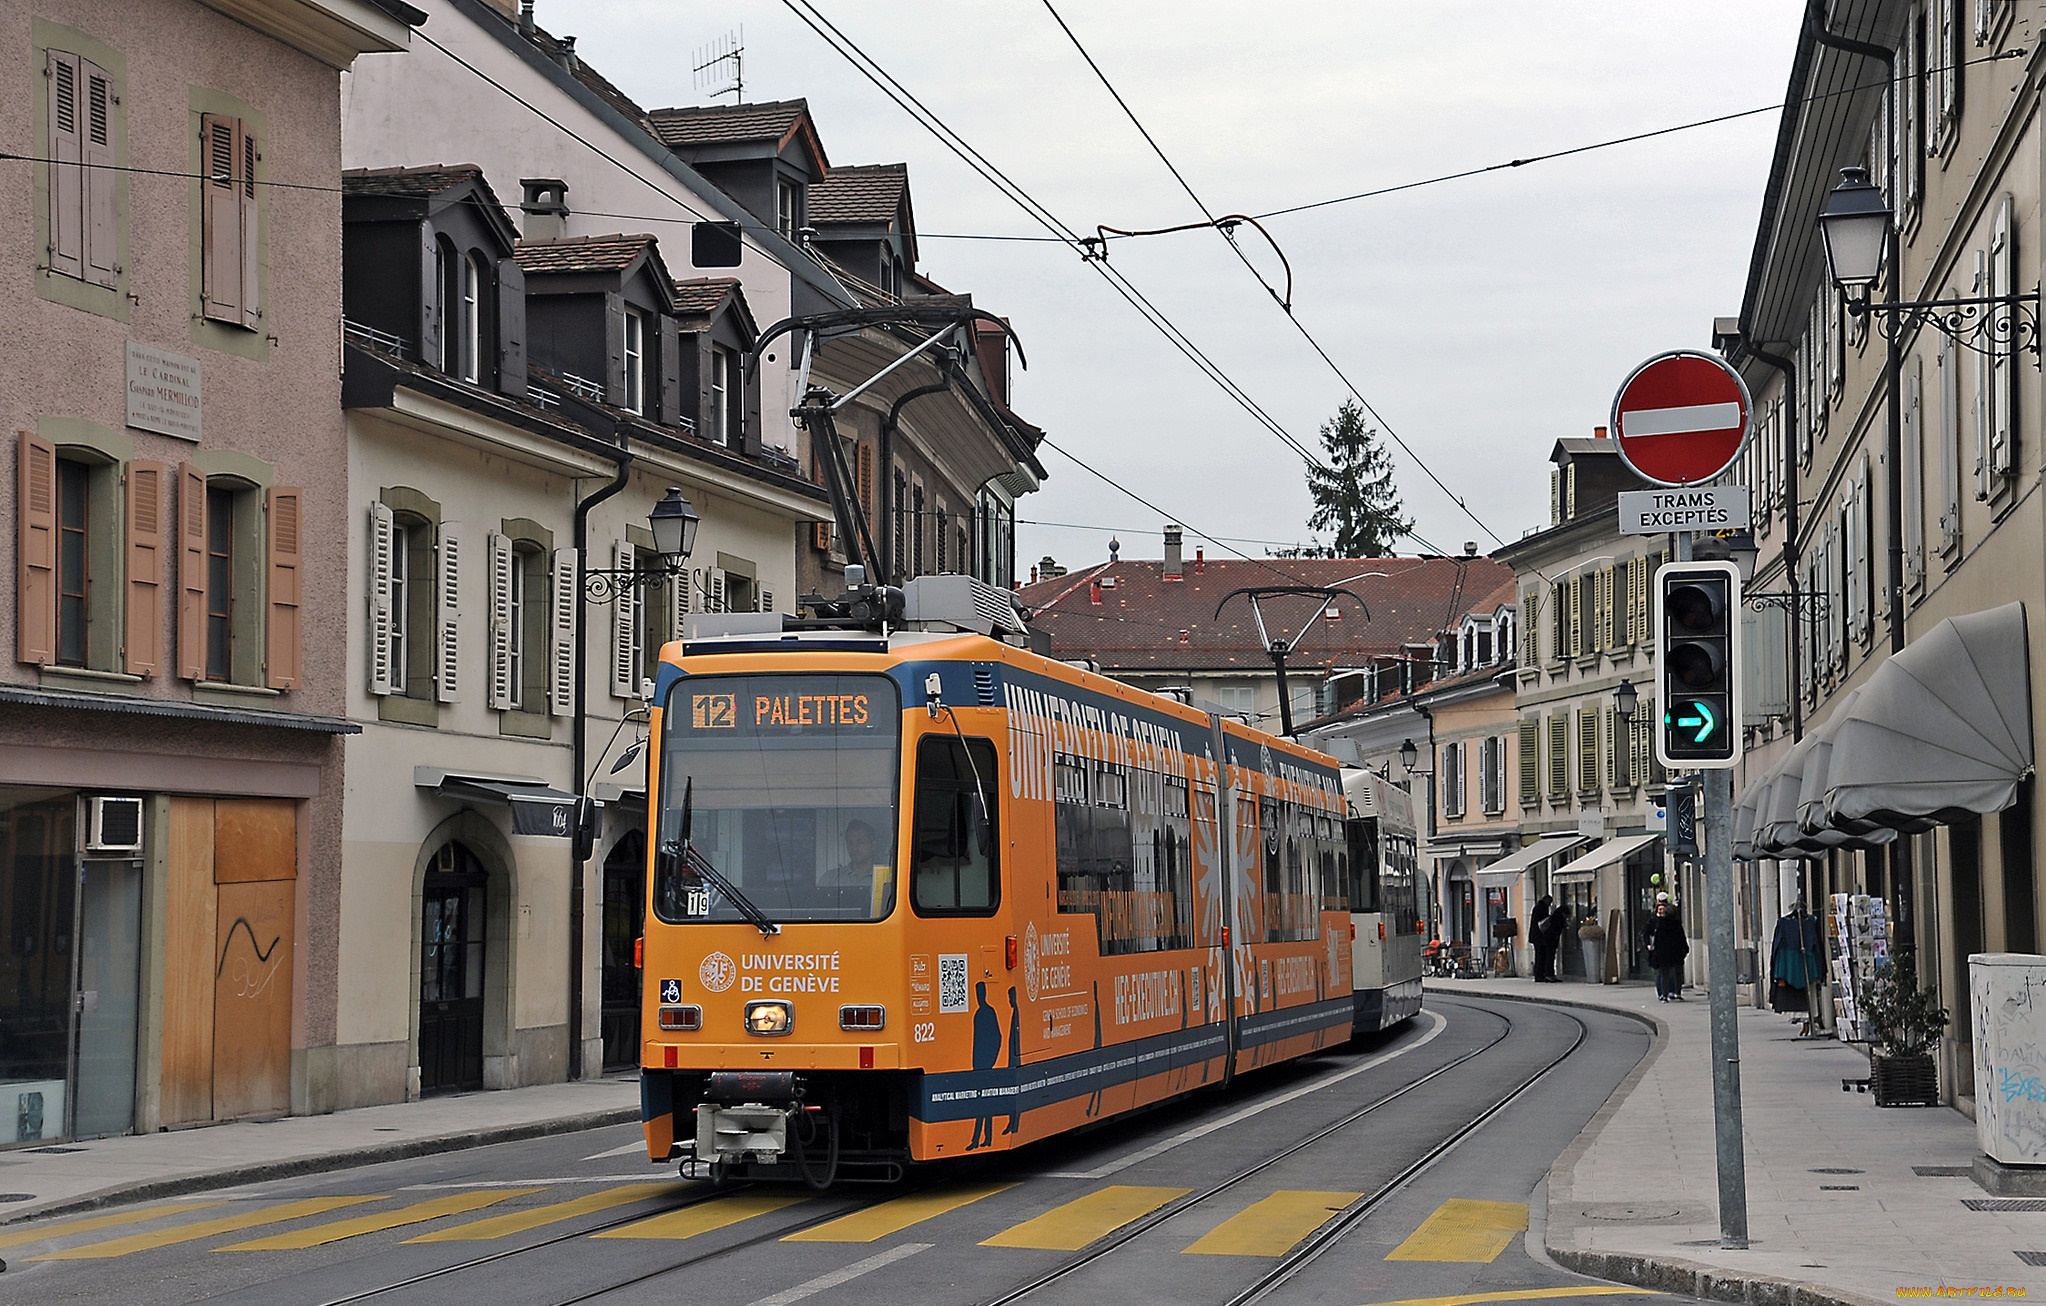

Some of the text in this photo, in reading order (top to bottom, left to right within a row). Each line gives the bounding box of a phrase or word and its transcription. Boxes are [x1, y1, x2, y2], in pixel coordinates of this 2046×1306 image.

[139, 366, 191, 388] LE CARDINAL
[156, 386, 200, 409] MERMILLOD
[1653, 492, 1715, 509] TRAMS
[1640, 507, 1729, 527] EXCEPTÉS
[696, 695, 869, 727] 12 PALETTES
[1040, 927, 1070, 957] UNIVERSITÉ
[741, 950, 840, 970] UNIVERSITÉ
[741, 972, 840, 993] DE GENÈVE
[1041, 961, 1071, 990] DE GENÈVE
[914, 1022, 935, 1043] 822
